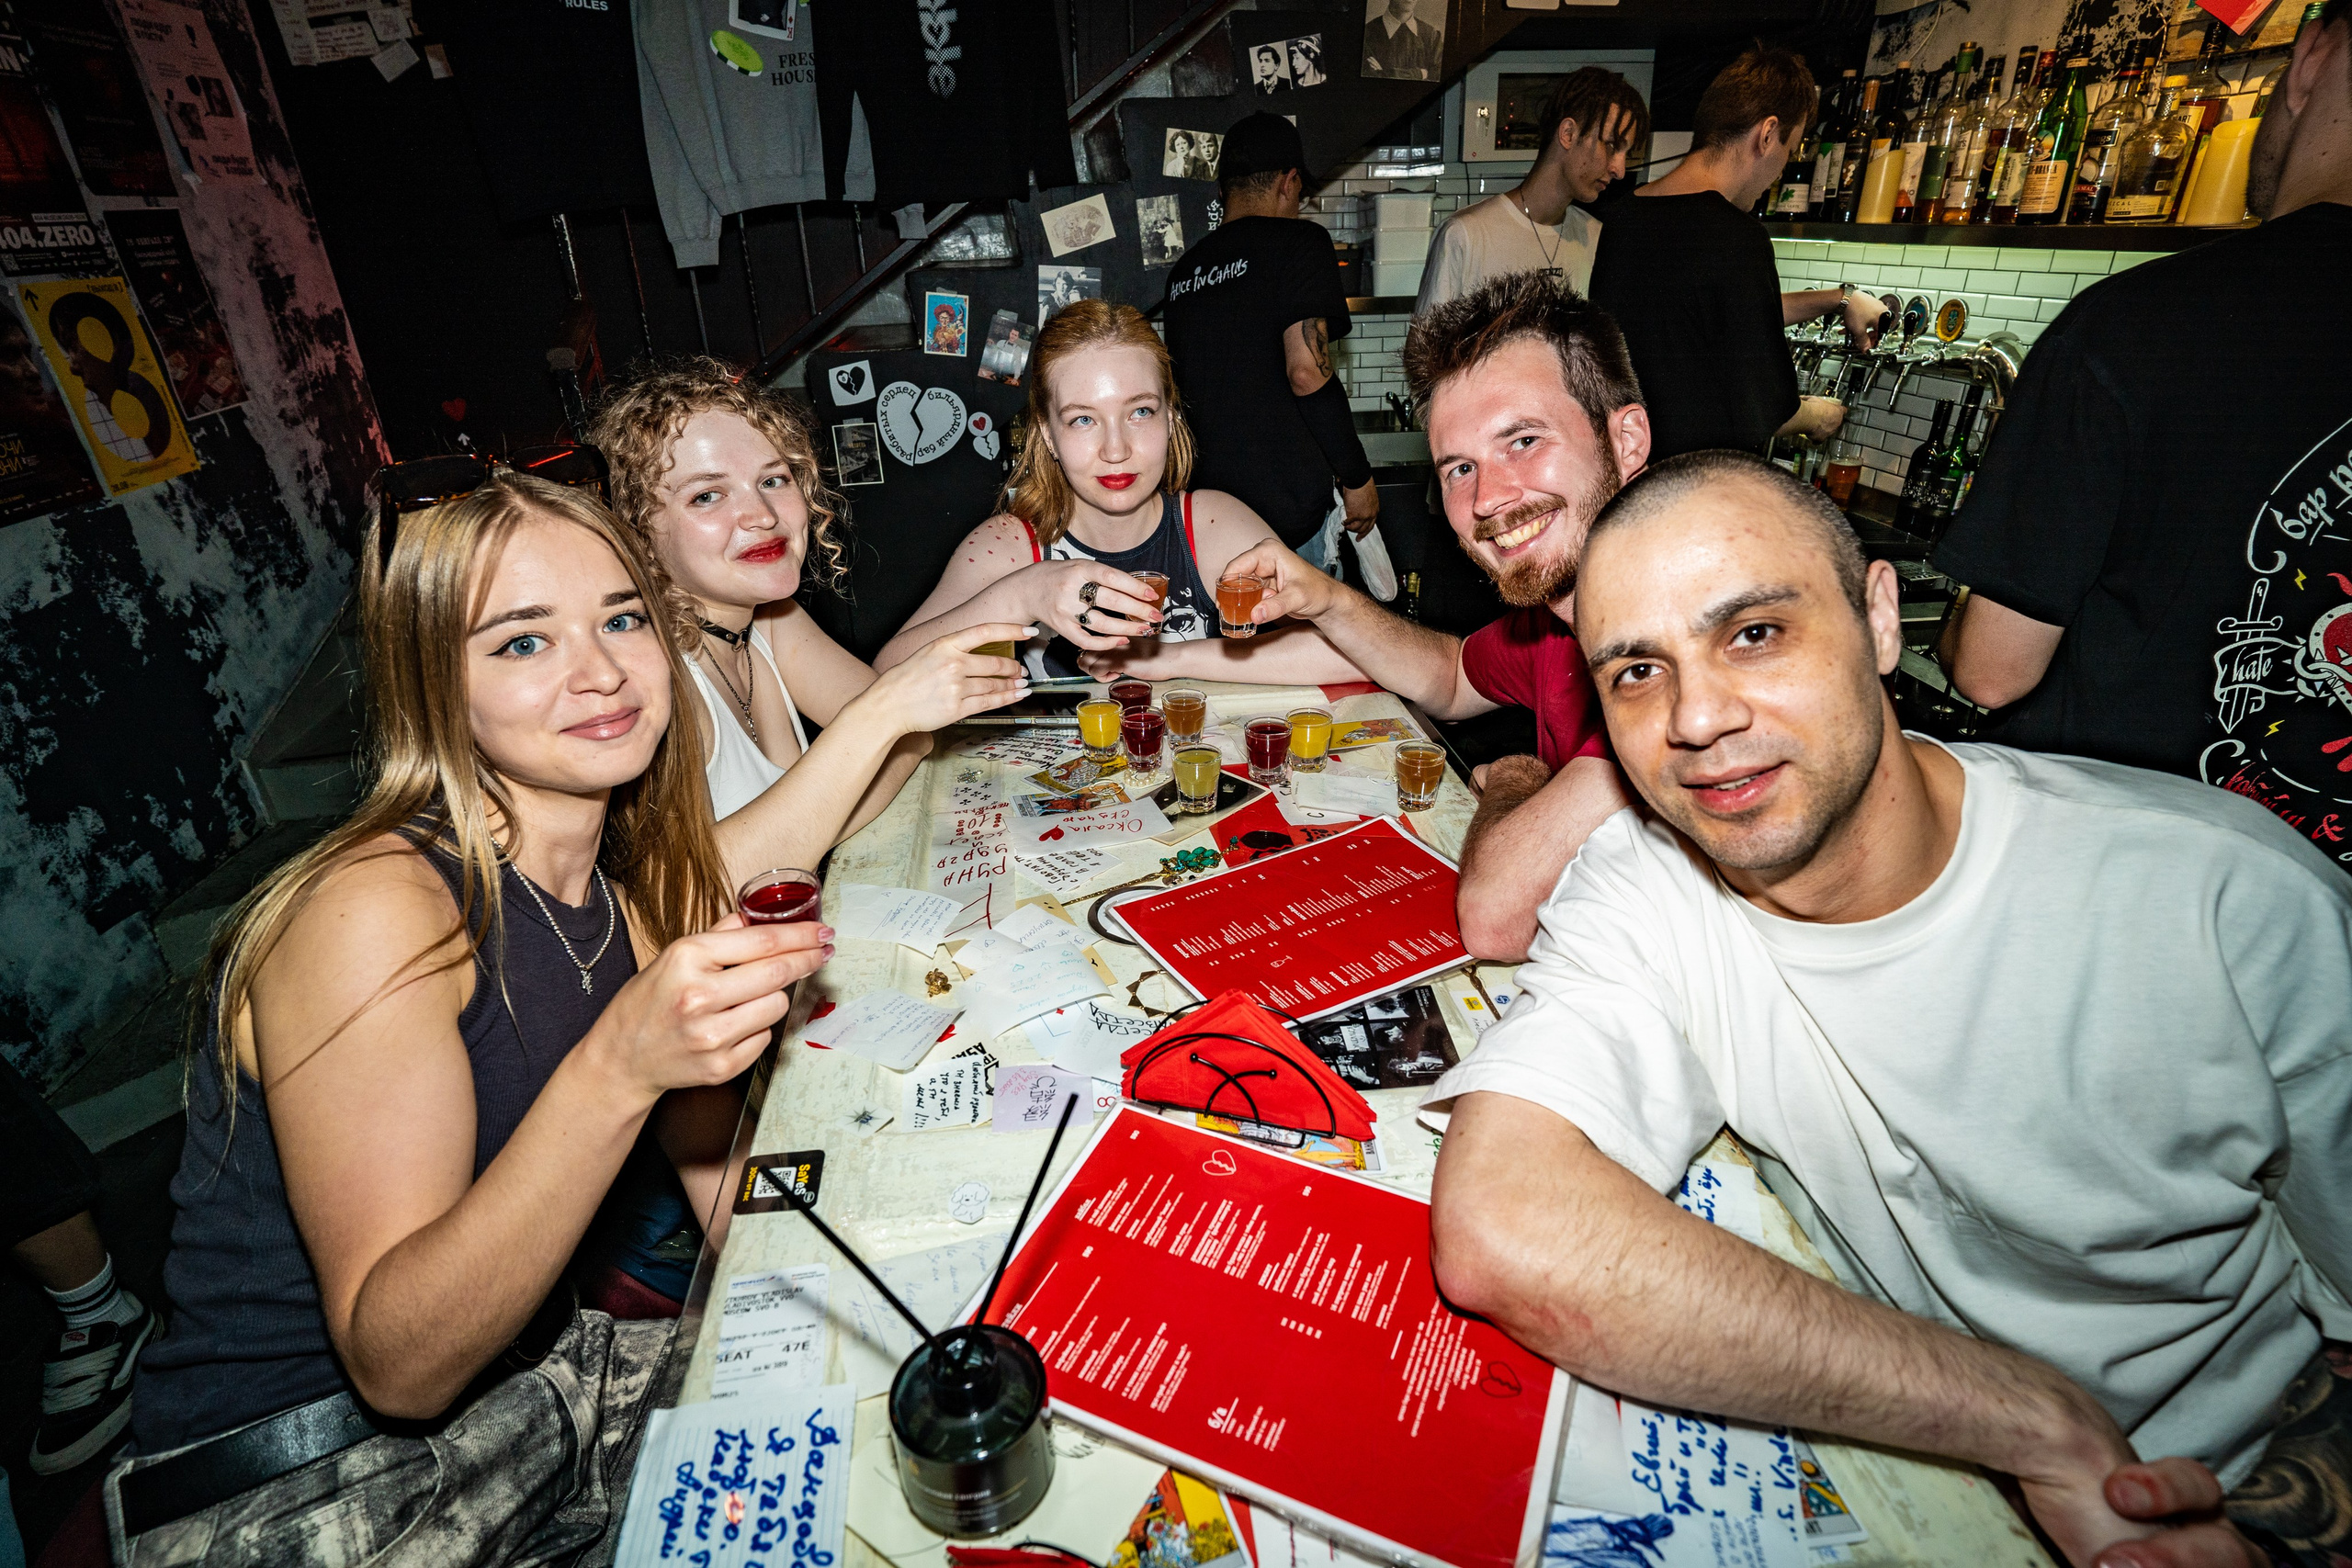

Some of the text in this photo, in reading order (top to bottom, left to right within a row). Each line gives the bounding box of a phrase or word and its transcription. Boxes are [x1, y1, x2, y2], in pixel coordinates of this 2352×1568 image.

[778, 52, 816, 69] FRES
[1170, 258, 1249, 301] ALICE IN CHAINS
[880, 386, 917, 462] разбитых сердец
[917, 390, 963, 458] бильярдный бар
[2269, 487, 2335, 540] бар
[2232, 646, 2285, 682] hate
[1067, 818, 1144, 833] Оксана
[715, 1349, 752, 1364] SEAT
[781, 1340, 810, 1354] 47E
